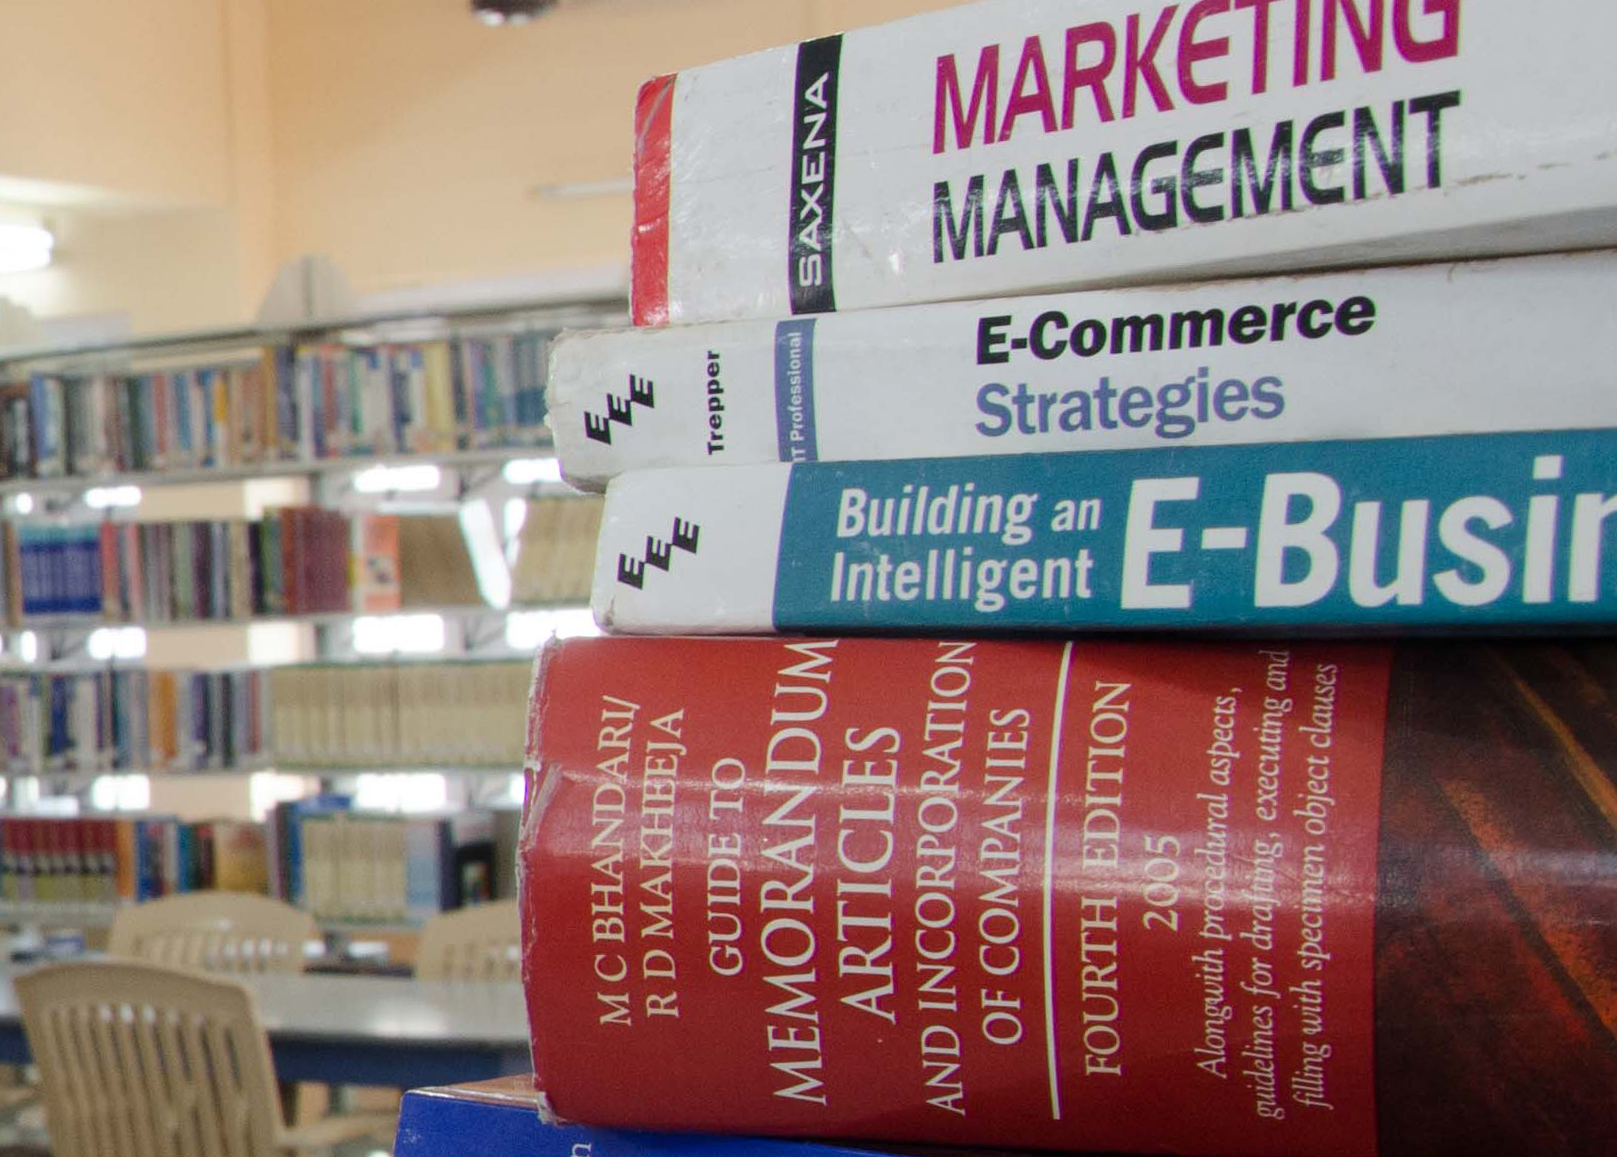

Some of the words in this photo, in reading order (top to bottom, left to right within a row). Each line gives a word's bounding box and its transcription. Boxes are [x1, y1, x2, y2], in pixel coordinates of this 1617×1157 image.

[932, 0, 1462, 154] MARKETING
[798, 72, 832, 289] SAXENA
[933, 90, 1462, 264] MANAGEMENT
[976, 295, 1377, 365] E-Commerce
[707, 350, 725, 455] Trepper
[787, 331, 806, 442] Professional
[976, 366, 1286, 441] Strategies
[836, 483, 1039, 545] Building
[1051, 497, 1101, 533] an
[831, 546, 1093, 613] Intelligent
[1259, 650, 1290, 692] and
[1298, 663, 1338, 749] clauses
[710, 757, 746, 821] TO
[1082, 680, 1133, 871] EDITION
[1206, 687, 1243, 787] aspects,
[1253, 696, 1293, 821] executing
[591, 694, 642, 944] BHANDARI/
[639, 708, 686, 940] MAKHEJA
[915, 641, 978, 1012] INCORPORATION
[978, 707, 1031, 976] COMPANIES
[1293, 754, 1336, 836] object
[707, 832, 743, 977] GUIDE
[760, 639, 839, 1107] MEMORANDUM
[837, 726, 901, 1025] ARTICLES
[1143, 835, 1182, 932] 2005
[1194, 793, 1232, 941] procedural
[1239, 831, 1284, 951] drafting,
[1297, 843, 1331, 971] specimen
[594, 953, 629, 982] C
[599, 992, 632, 1027] M
[643, 952, 678, 981] D
[644, 991, 680, 1019] R
[981, 989, 1023, 1046] OF
[1080, 896, 1123, 1076] FOURTH
[1191, 948, 1233, 1079] Alongwith
[1240, 957, 1281, 999] for
[1289, 979, 1324, 1037] with
[921, 1025, 966, 1116] AND
[1241, 1005, 1285, 1120] guidelines
[1291, 1041, 1334, 1111] filling
